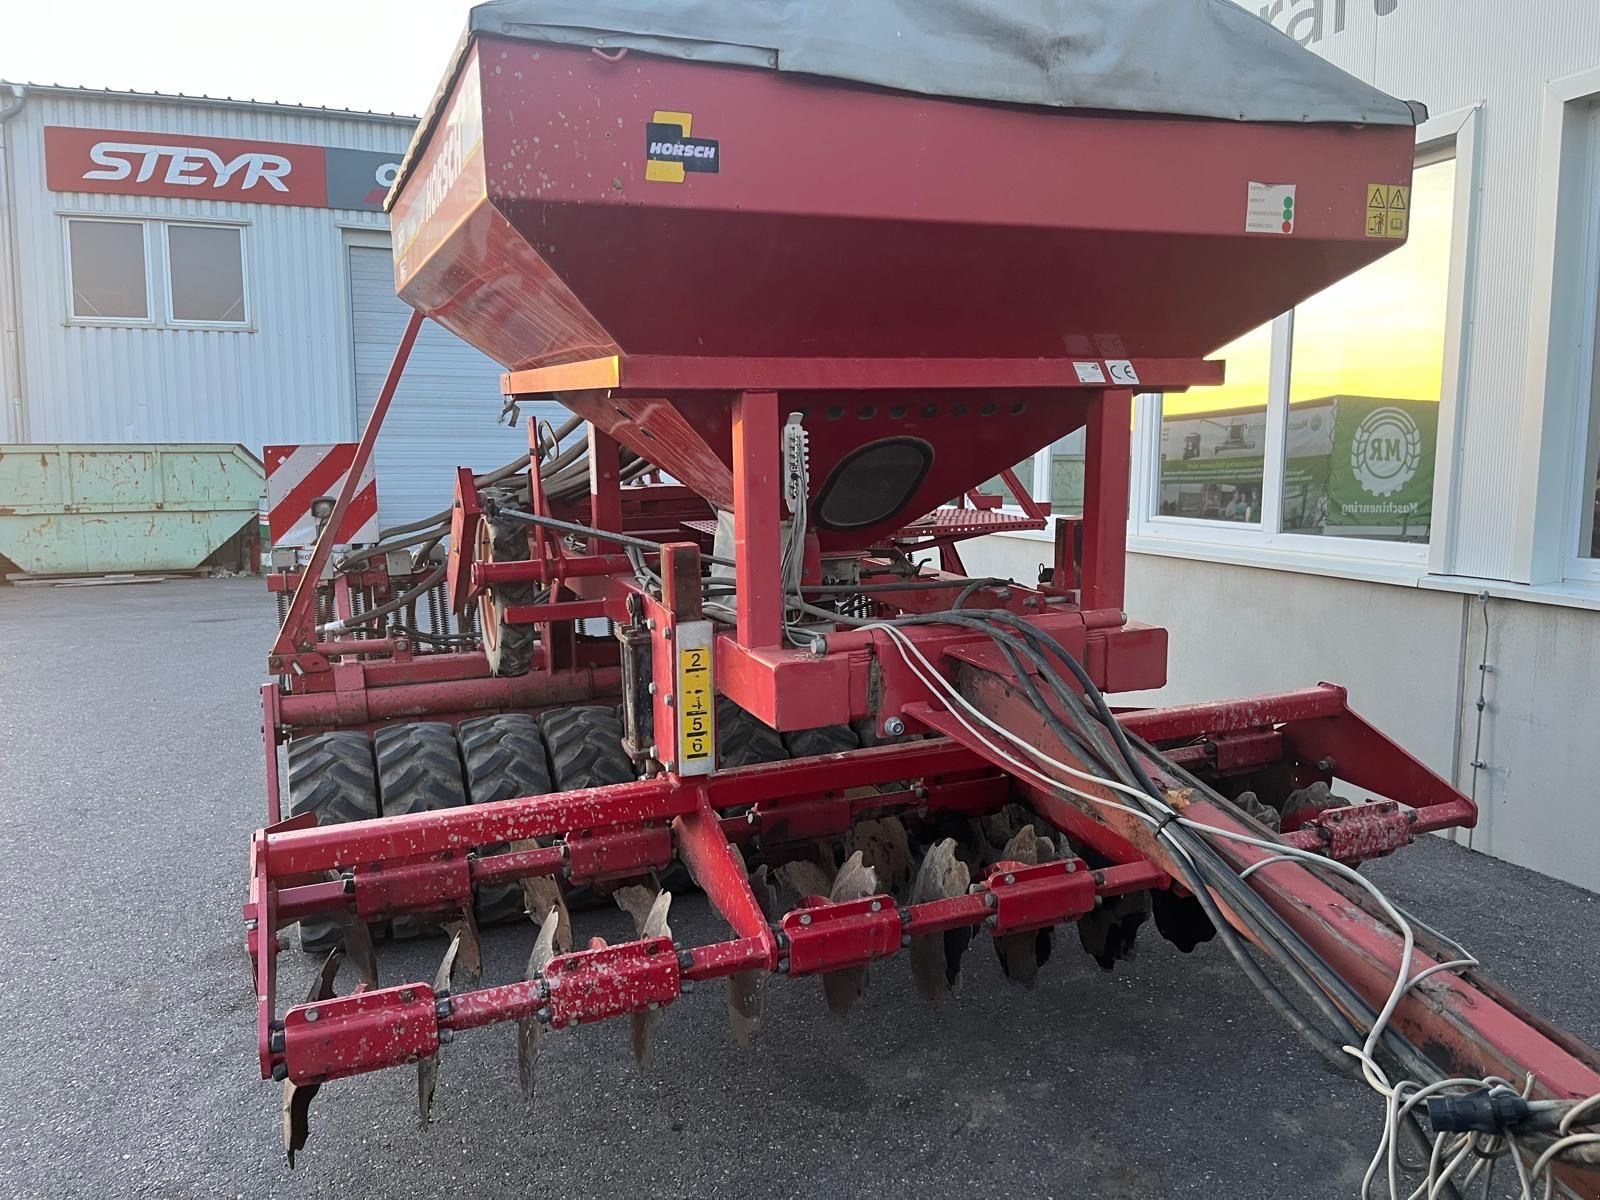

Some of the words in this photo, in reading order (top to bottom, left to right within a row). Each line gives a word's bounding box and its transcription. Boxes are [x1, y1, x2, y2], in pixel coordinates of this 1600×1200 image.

[649, 142, 716, 159] HORSCH
[82, 141, 292, 193] STEYR
[424, 121, 463, 224] HORSCH
[1109, 364, 1137, 380] CE
[691, 653, 702, 667] 2
[692, 717, 703, 731] 5
[692, 738, 703, 752] 6
